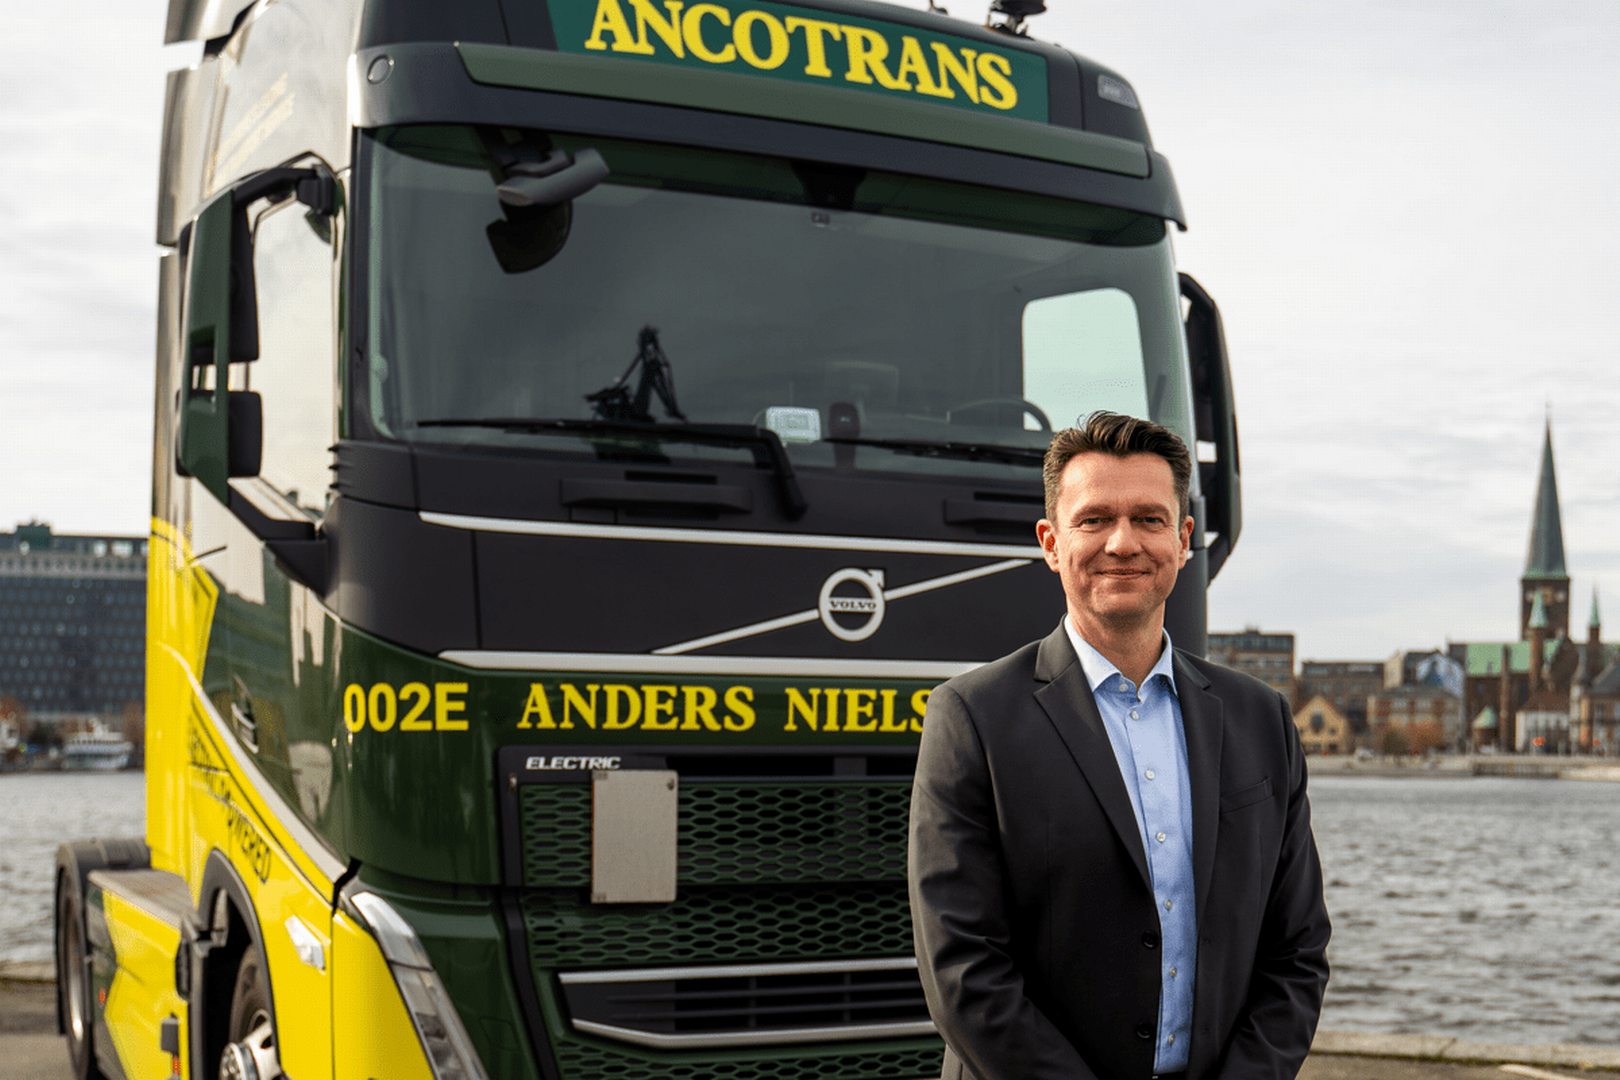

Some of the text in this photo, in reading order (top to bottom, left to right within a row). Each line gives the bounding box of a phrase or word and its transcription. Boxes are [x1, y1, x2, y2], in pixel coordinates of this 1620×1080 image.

[584, 0, 1018, 110] ANCOTRANS
[829, 600, 877, 610] VOLVO
[343, 682, 470, 733] 002E
[516, 683, 757, 732] ANDERS
[525, 756, 622, 770] ELECTRIC
